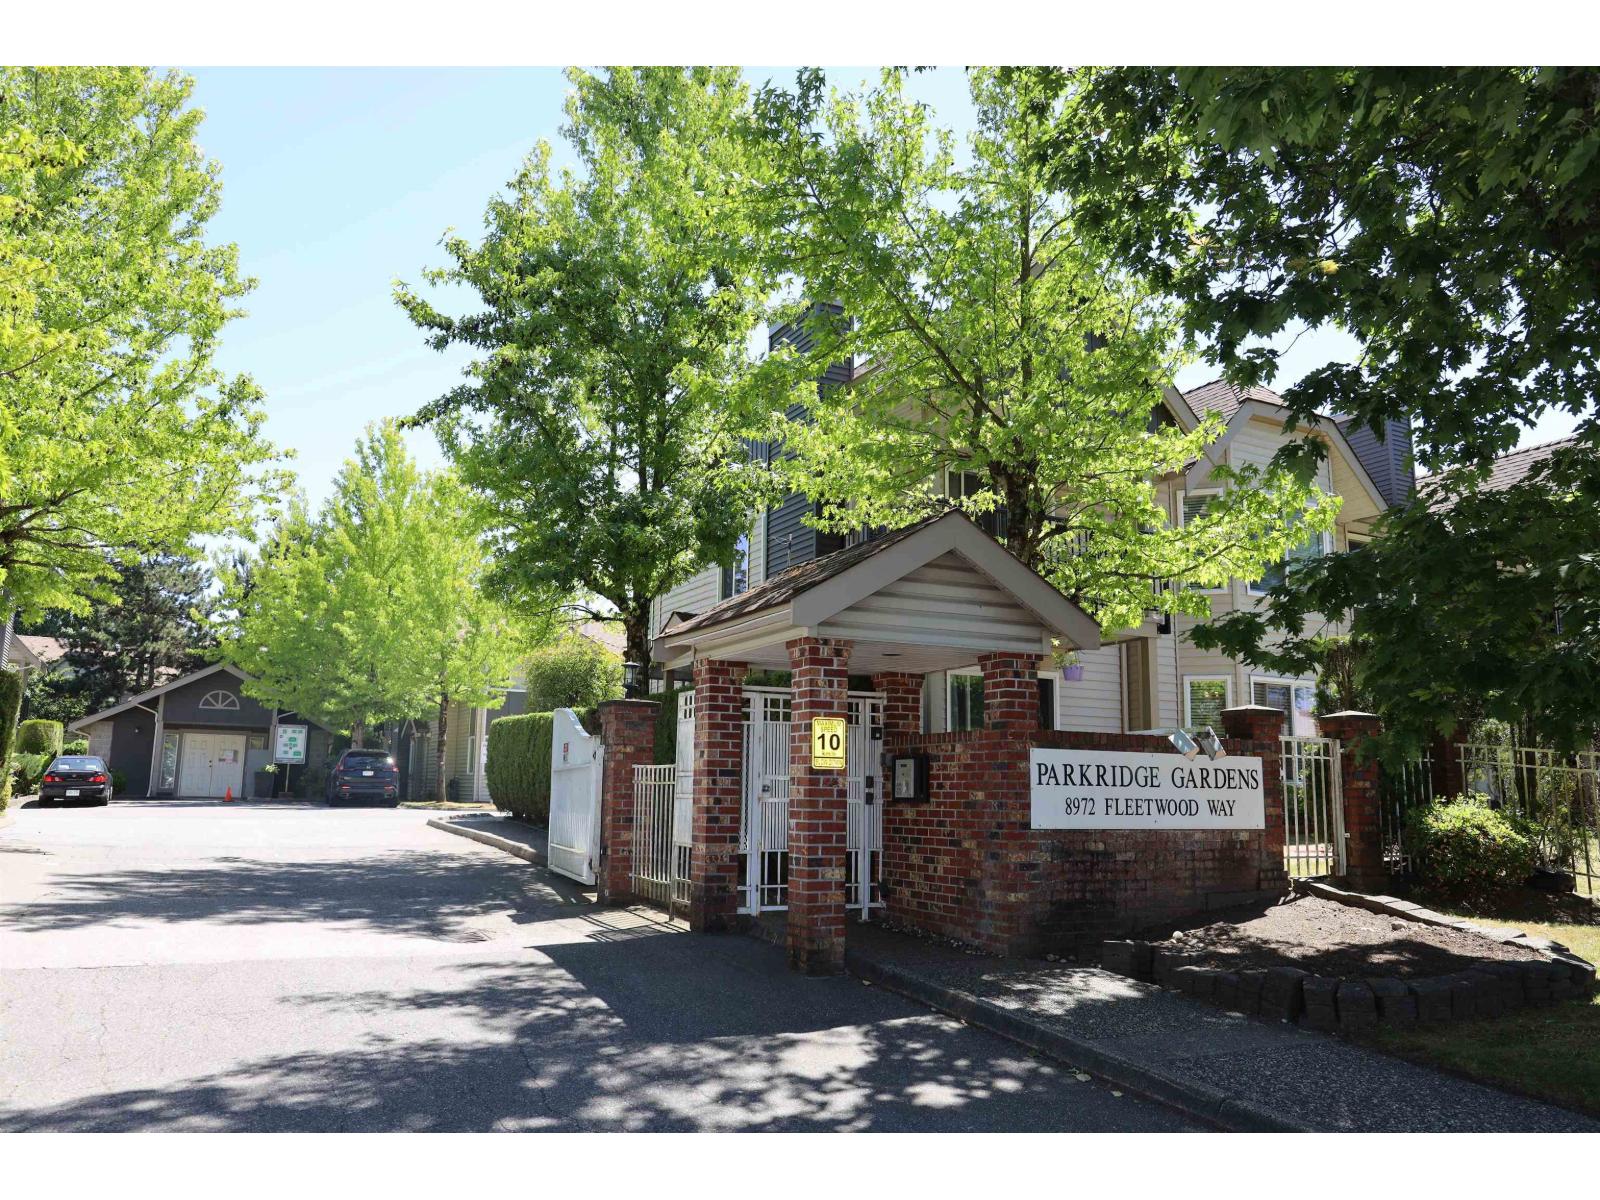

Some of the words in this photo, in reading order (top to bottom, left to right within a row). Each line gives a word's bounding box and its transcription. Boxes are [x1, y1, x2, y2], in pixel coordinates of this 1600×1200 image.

[817, 733, 840, 751] 10
[1036, 762, 1161, 788] PARKRIDGE
[1171, 766, 1259, 790] GARDENS
[1064, 797, 1096, 816] 8972
[1104, 798, 1199, 817] FLEETWOOD
[1208, 799, 1236, 817] WAY
